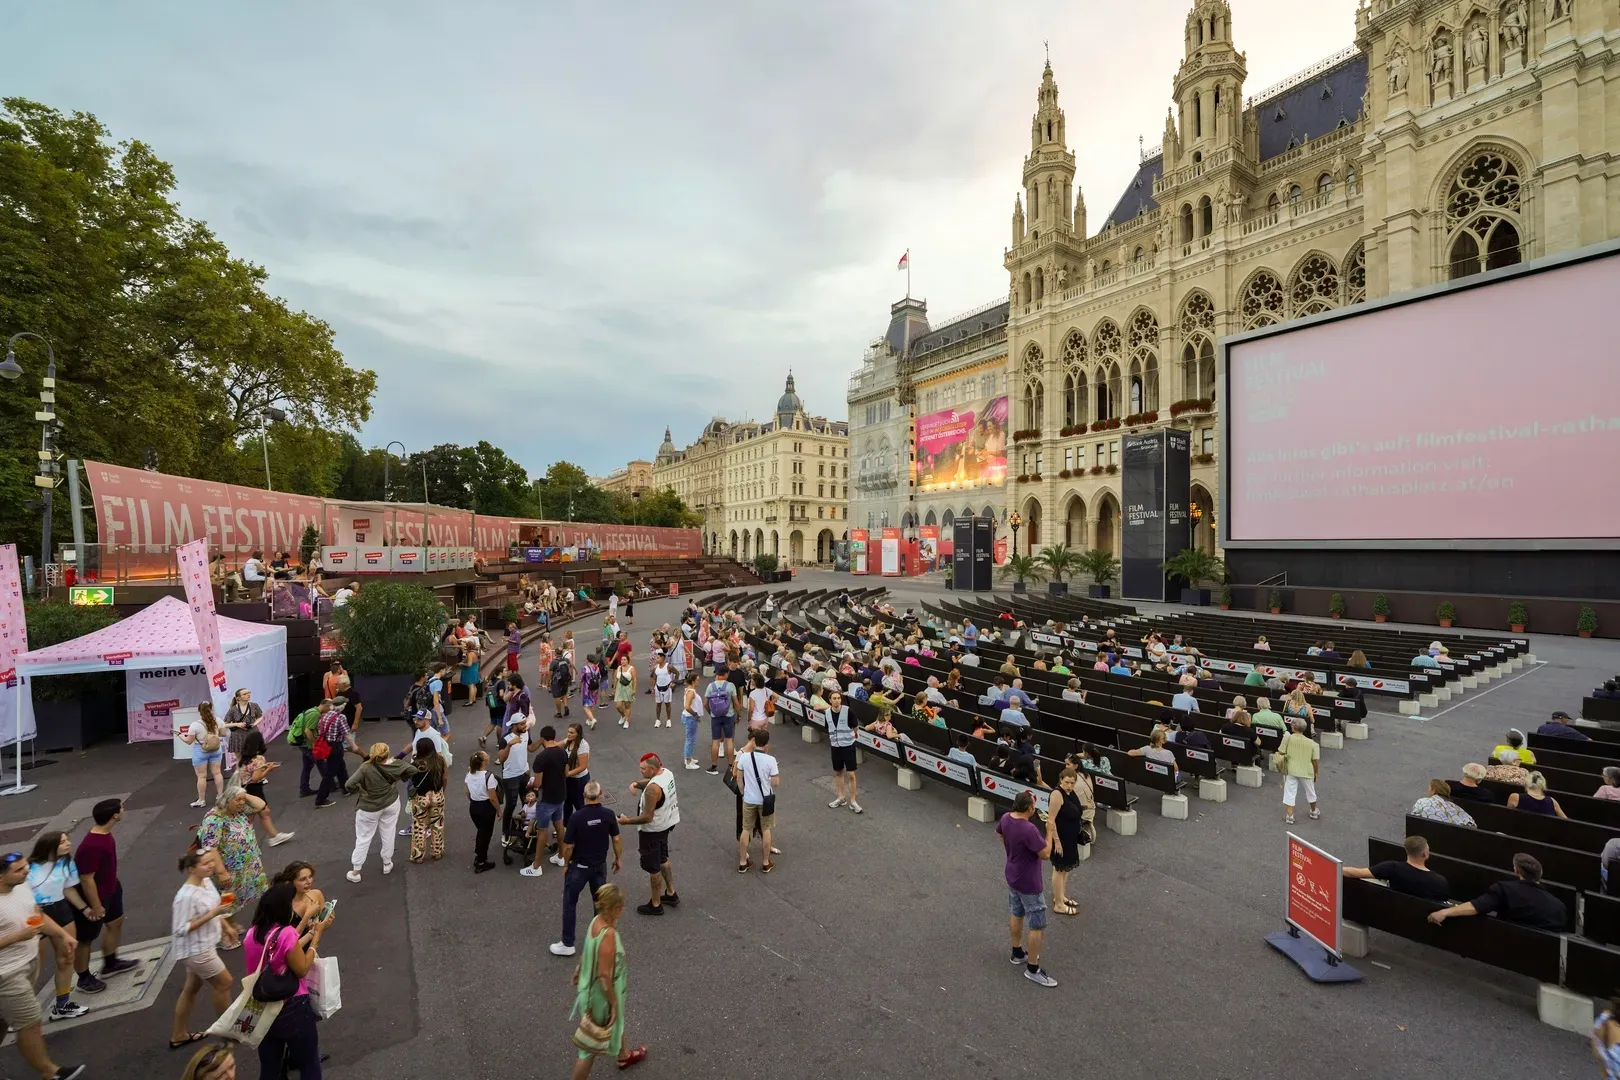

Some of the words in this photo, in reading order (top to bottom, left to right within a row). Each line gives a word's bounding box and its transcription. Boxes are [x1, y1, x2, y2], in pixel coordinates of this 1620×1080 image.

[1129, 504, 1144, 512] FILM
[1129, 510, 1158, 520] FESTIVAL
[1170, 511, 1187, 519] FESTIVAL
[101, 495, 195, 554] FILM
[605, 533, 658, 551] FESTIVAL
[140, 667, 187, 679] meine
[1292, 844, 1302, 853] FILM
[1292, 850, 1312, 865] FESTIVAL
